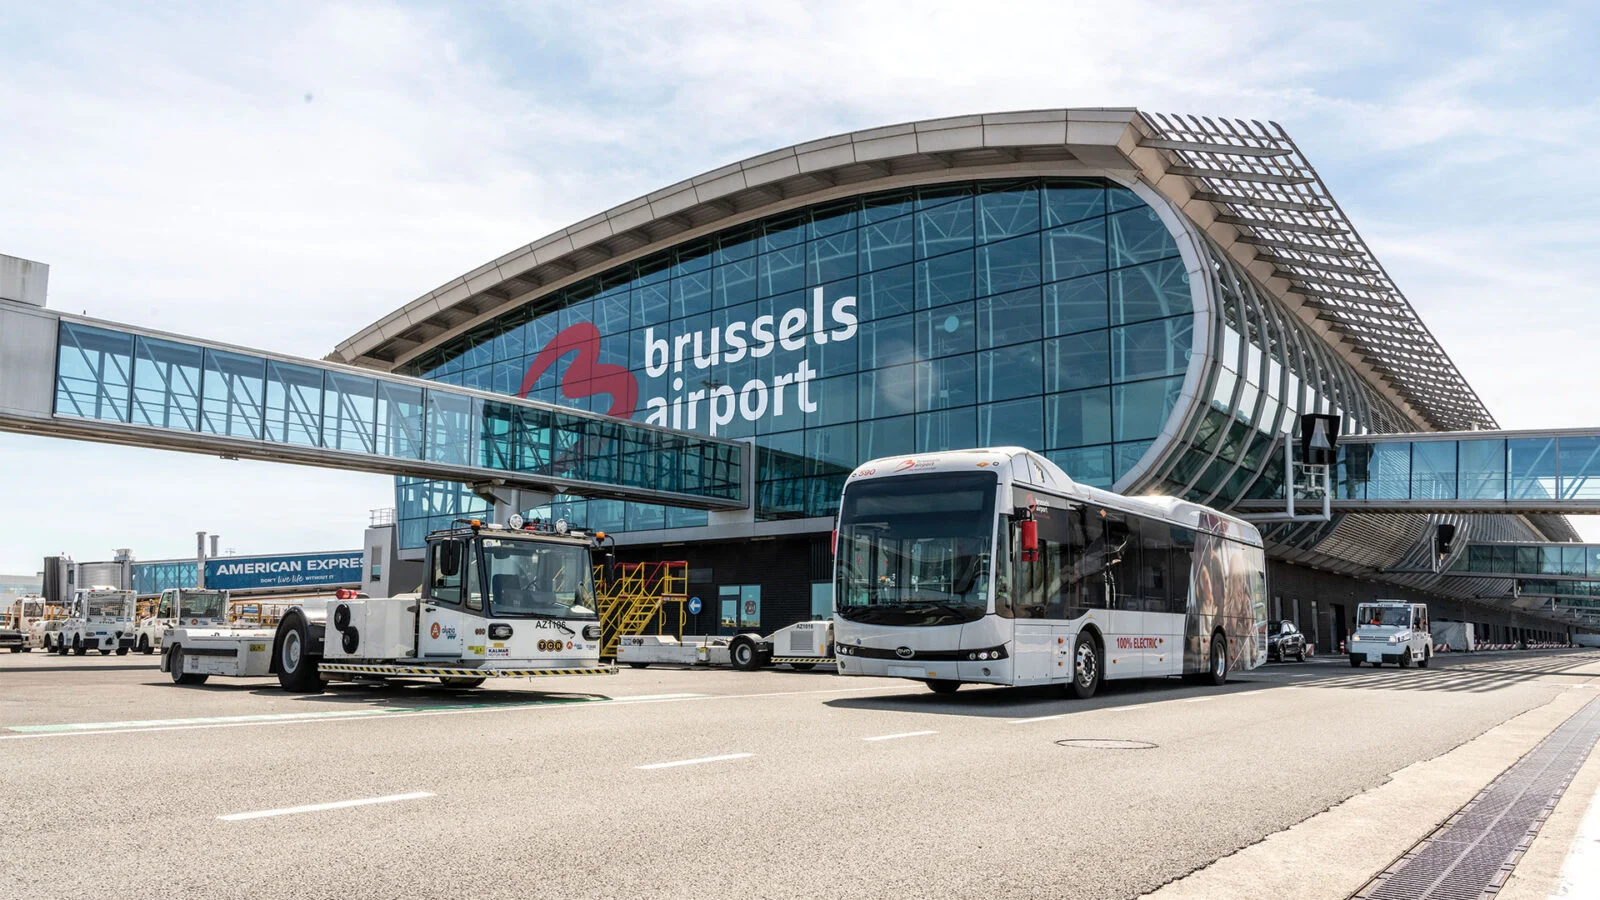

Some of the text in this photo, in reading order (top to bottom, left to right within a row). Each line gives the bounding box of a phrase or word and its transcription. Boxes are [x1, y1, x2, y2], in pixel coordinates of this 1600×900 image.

[644, 286, 858, 378] brussels
[645, 359, 818, 437] airport
[858, 468, 876, 477] 590
[216, 560, 301, 576] AMERICAN
[277, 574, 291, 584] live
[291, 573, 304, 584] life
[538, 640, 563, 651] TCR
[1116, 637, 1158, 649] 100% ELECTRIC
